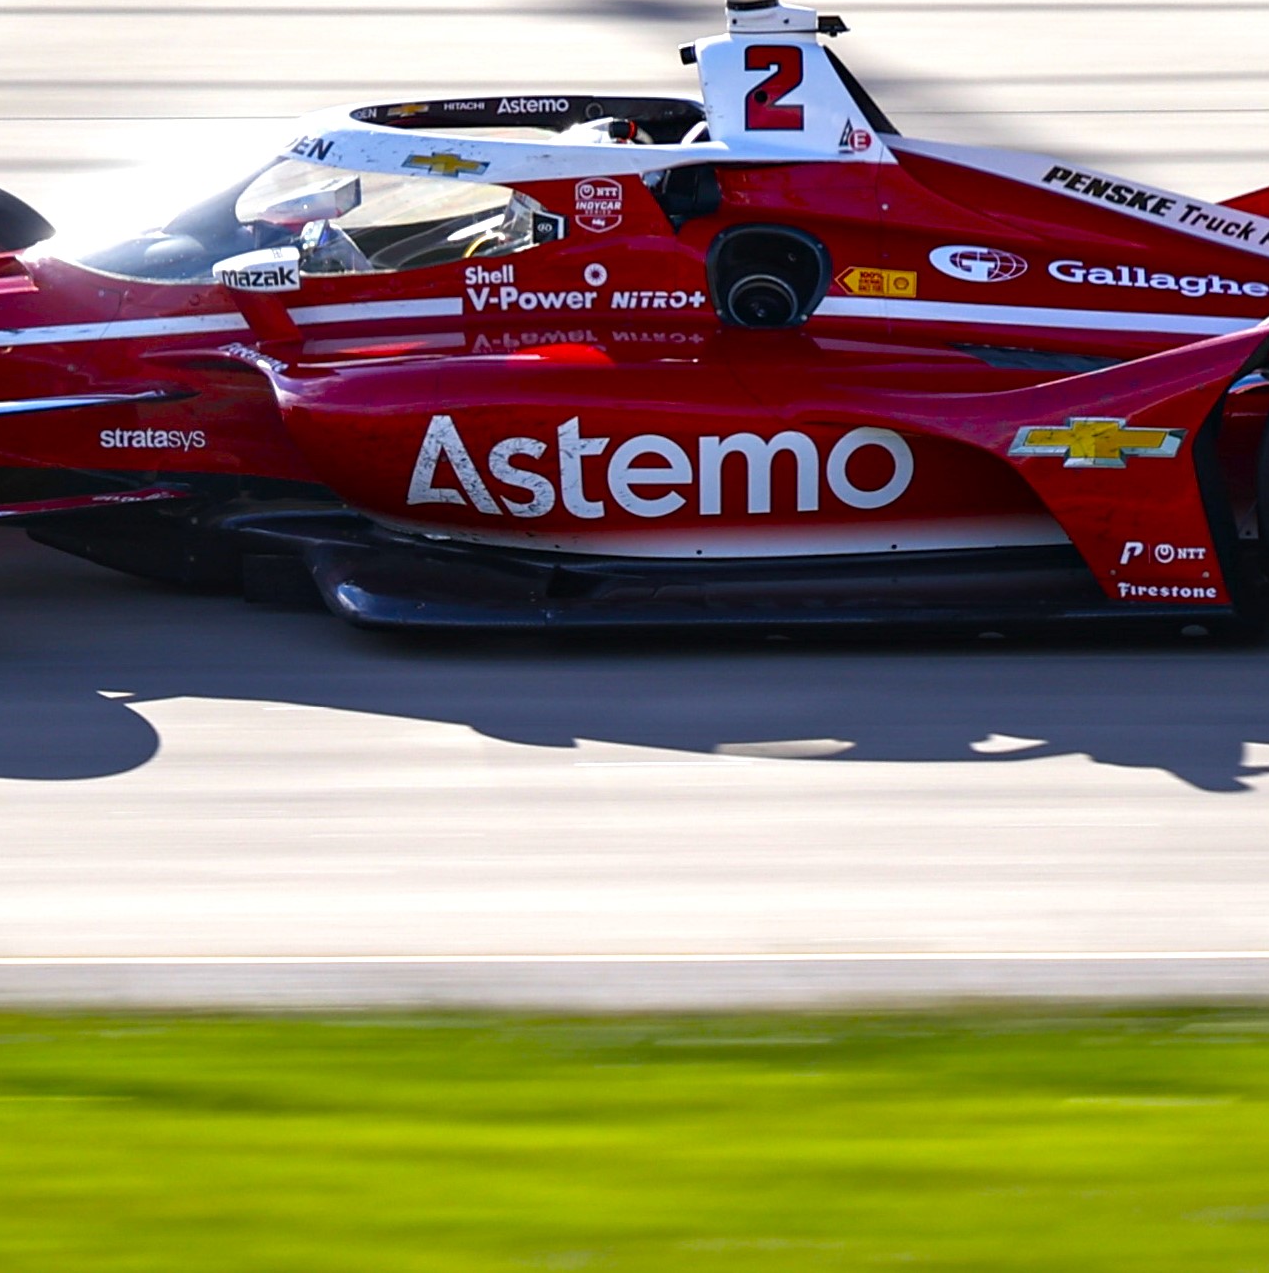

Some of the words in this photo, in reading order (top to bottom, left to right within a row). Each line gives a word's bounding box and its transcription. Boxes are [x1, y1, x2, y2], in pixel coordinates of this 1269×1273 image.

[745, 44, 804, 131] 2
[444, 102, 485, 111] HITACHI
[496, 97, 569, 114] Astemo
[596, 187, 618, 197] NTT
[575, 201, 622, 210] INDYCAR
[1041, 165, 1177, 218] PENSKE
[1178, 203, 1257, 242] Truck
[465, 264, 514, 285] Shell
[466, 286, 598, 311] V-Power
[99, 427, 206, 452] stratasys
[406, 414, 915, 519] Astemo
[1177, 547, 1207, 560] NTT
[1117, 582, 1218, 598] Firestone
